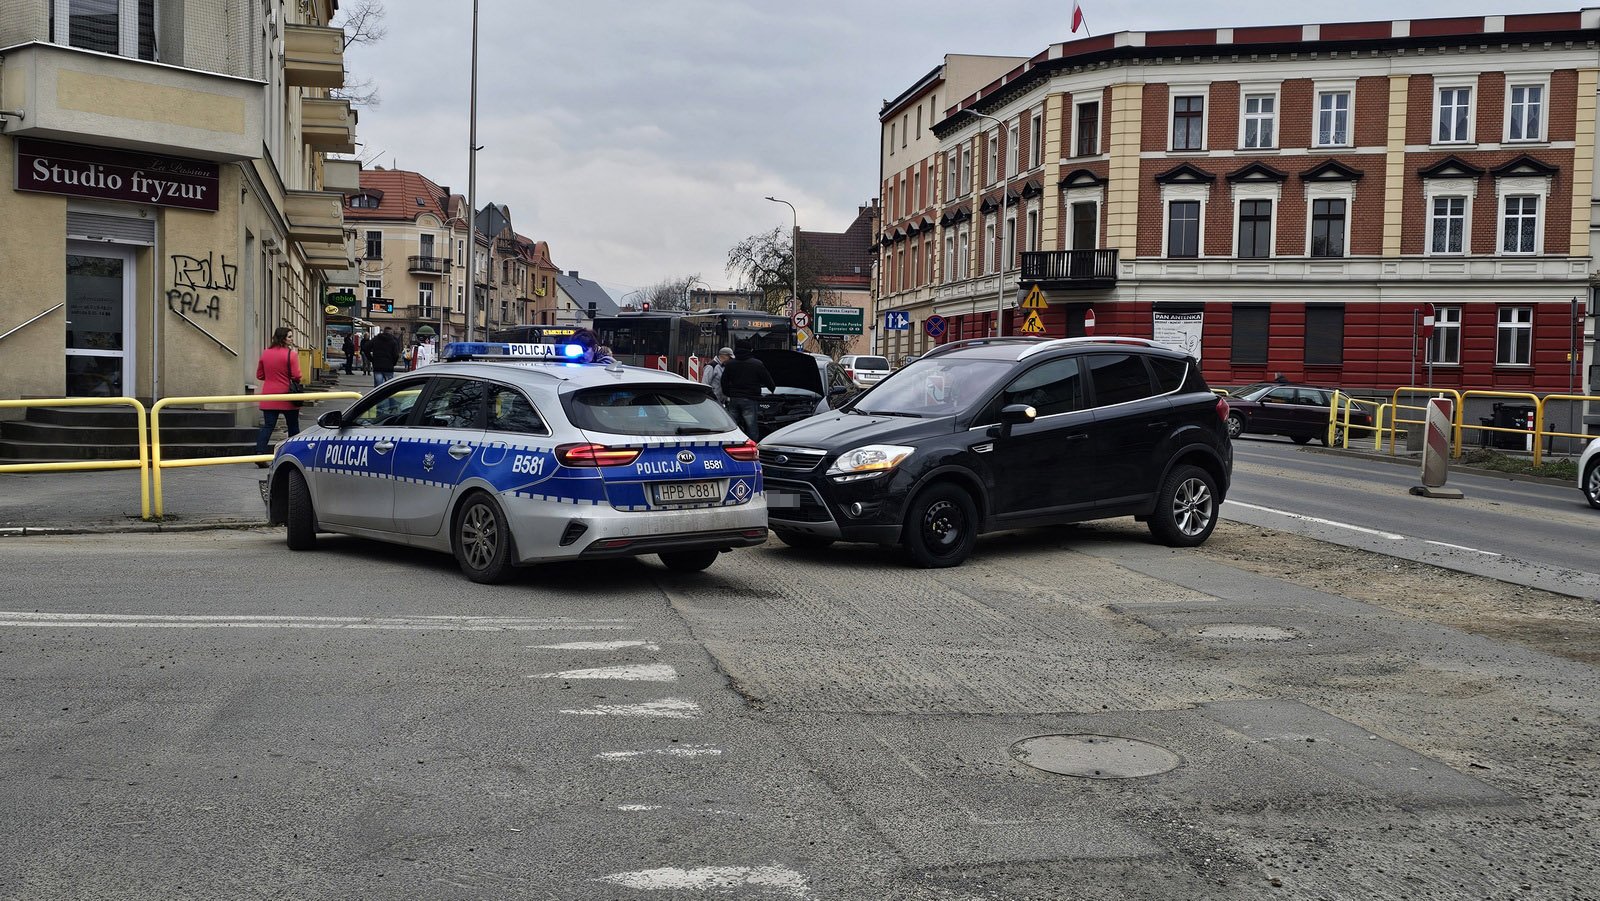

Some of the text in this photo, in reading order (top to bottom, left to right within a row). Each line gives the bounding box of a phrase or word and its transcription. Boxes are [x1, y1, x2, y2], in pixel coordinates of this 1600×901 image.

[33, 158, 206, 202] Studio fryzur
[511, 344, 553, 356] POLICJA
[324, 444, 368, 467] POLICJA
[511, 454, 545, 476] B581
[636, 460, 683, 475] POLICJA
[703, 460, 723, 470] B581
[661, 482, 716, 499] HPB C881
